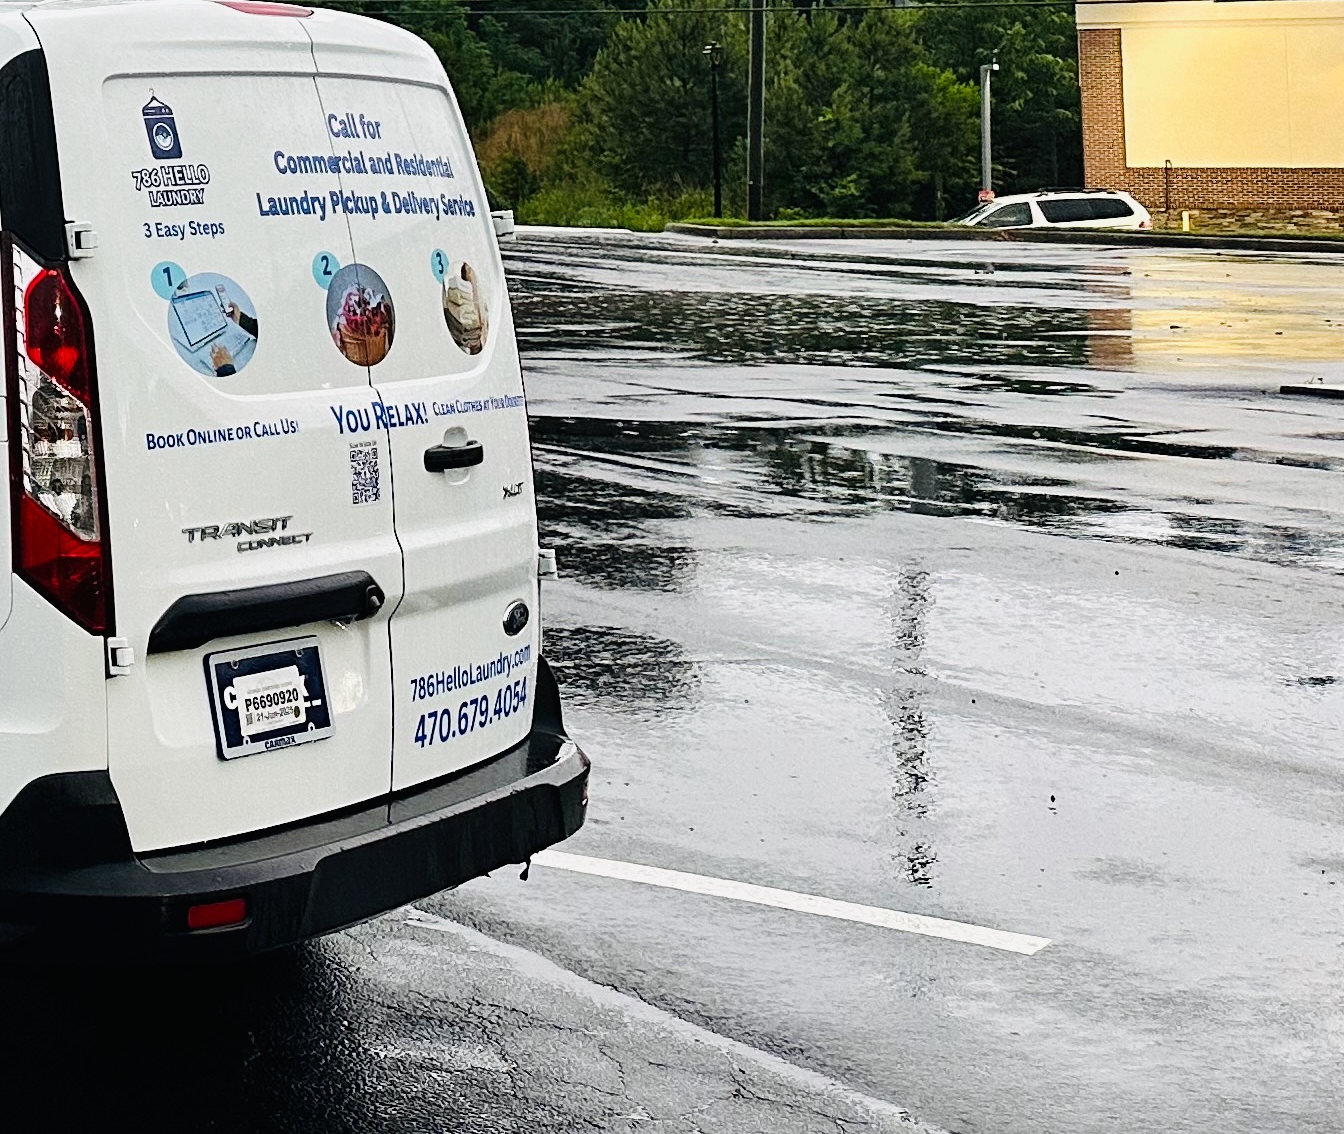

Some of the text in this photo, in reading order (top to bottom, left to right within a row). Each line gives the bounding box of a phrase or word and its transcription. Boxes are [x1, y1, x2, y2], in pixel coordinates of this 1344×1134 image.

[327, 112, 382, 140] Call for
[131, 164, 211, 191] 786 HELLO
[273, 150, 455, 179] Commercial and Residential
[148, 188, 206, 208] LAUNDRY
[256, 189, 476, 221] Laundry Pickup & Delivery Service
[142, 220, 226, 241] 3 Easy Steps
[162, 266, 174, 287] 1
[320, 255, 332, 276] 2
[435, 251, 445, 276] 3
[181, 515, 294, 544] TRANSIT
[237, 531, 314, 554] CONNECT
[410, 644, 531, 702] 786HelloLaundry.com
[244, 687, 299, 713] P6690920
[414, 675, 528, 748] 470.679.4054
